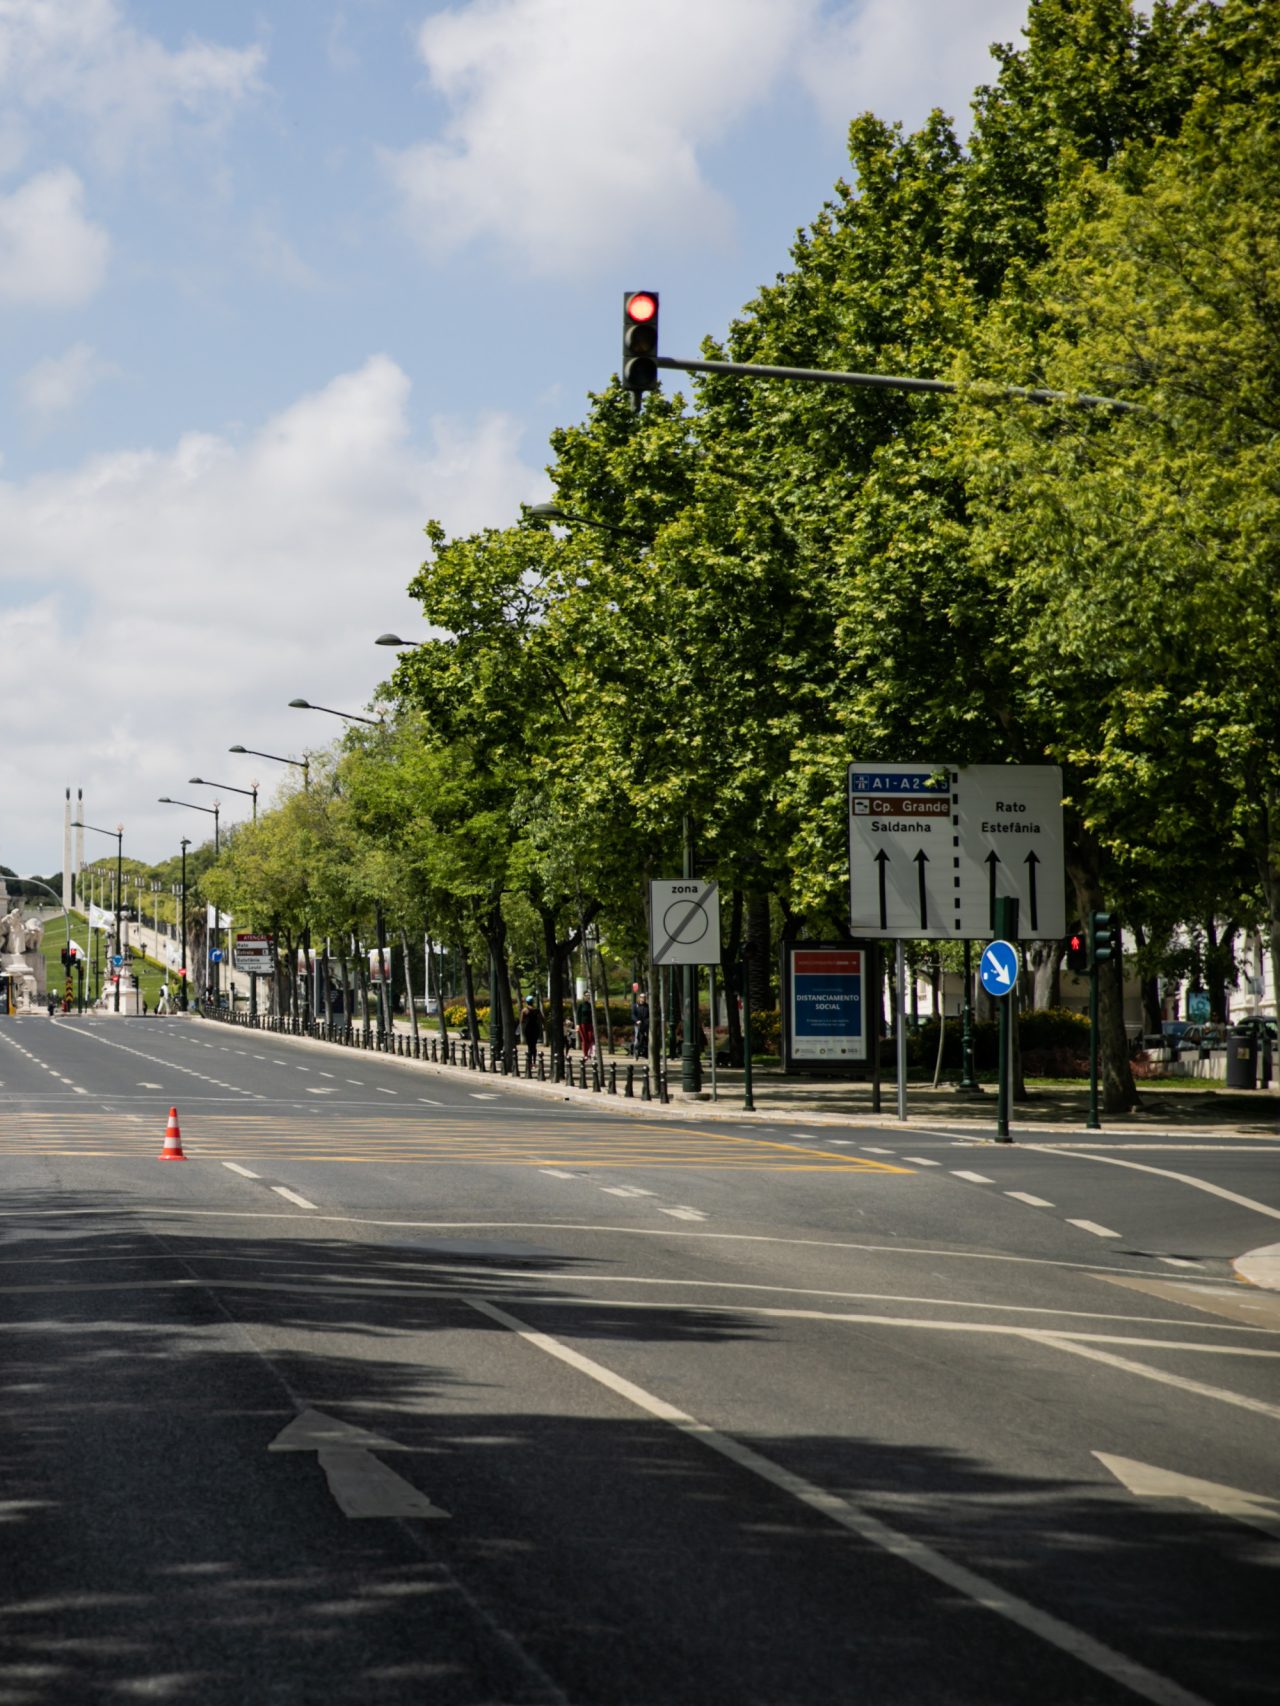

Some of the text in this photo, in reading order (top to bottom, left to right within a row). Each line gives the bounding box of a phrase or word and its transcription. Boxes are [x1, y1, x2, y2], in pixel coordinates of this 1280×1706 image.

[873, 800, 949, 813] Cp. Grande
[995, 801, 1026, 813] Rato
[871, 821, 932, 832] Saldanha
[981, 822, 1041, 833] Estefânia
[671, 886, 698, 894] zona
